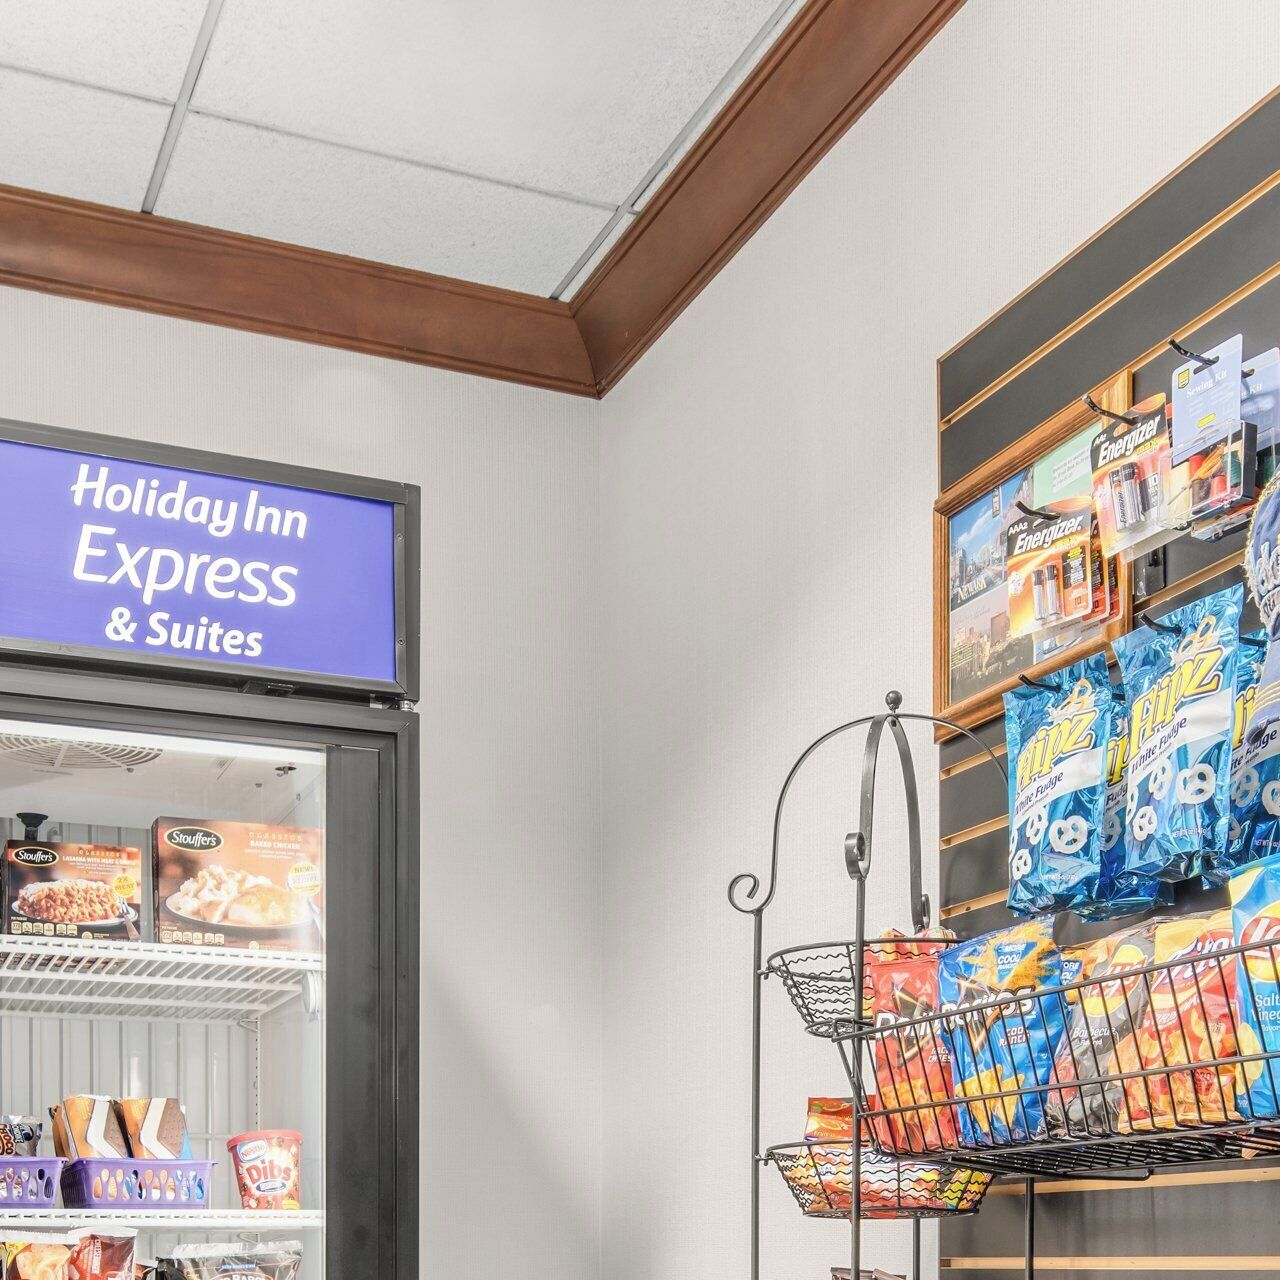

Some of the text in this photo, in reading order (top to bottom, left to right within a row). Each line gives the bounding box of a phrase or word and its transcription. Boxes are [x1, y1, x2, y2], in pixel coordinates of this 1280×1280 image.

[1187, 369, 1227, 398] Sewing Kit
[1098, 415, 1160, 466] Energizer
[71, 463, 308, 539] Holiday Inn
[1008, 522, 1028, 536] AAA2
[1013, 515, 1083, 555] Energizer
[73, 524, 298, 607] Express
[105, 607, 263, 657] & Suites
[1130, 716, 1187, 773] White Fudge
[1036, 771, 1064, 798] Fudge
[171, 831, 216, 847] Stouffer's
[250, 840, 271, 848] BAKED
[17, 851, 54, 863] Stouffer's
[997, 954, 1020, 964] COOL
[1255, 993, 1280, 1008] Salt
[1073, 1027, 1116, 1038] Barbecue
[246, 1159, 293, 1182] Dibs
